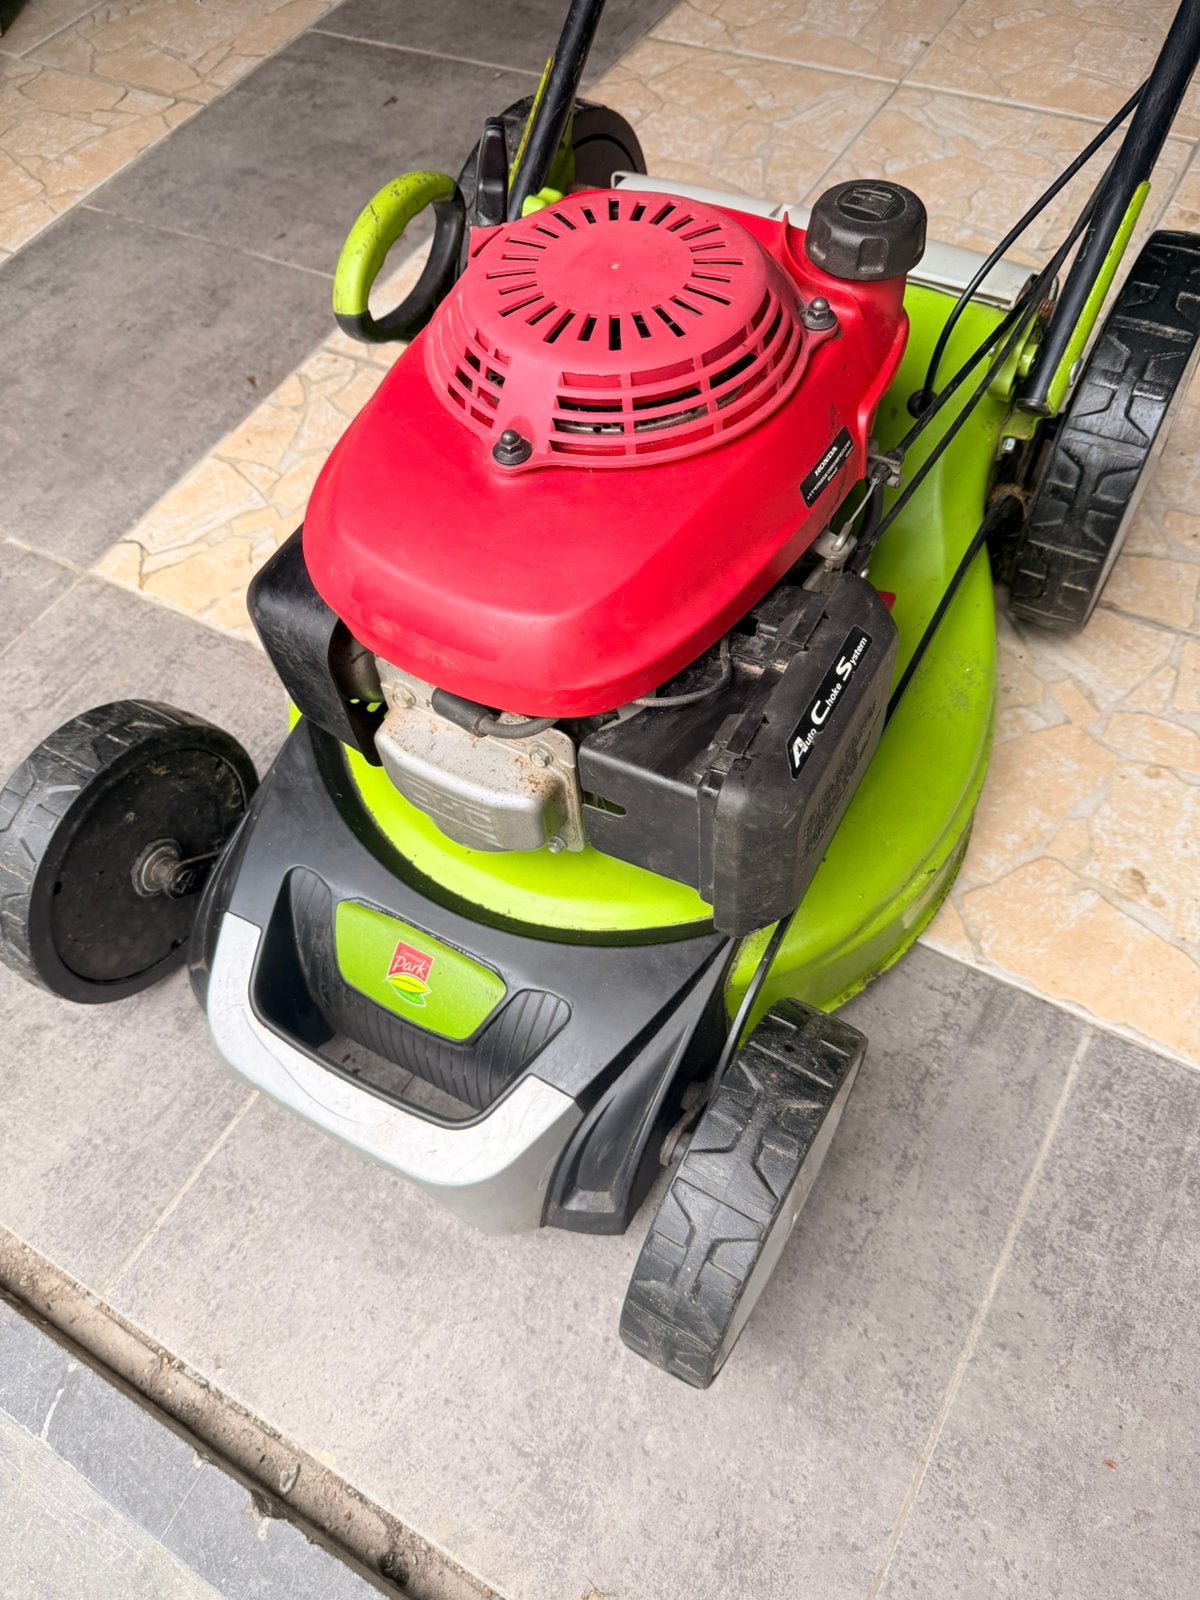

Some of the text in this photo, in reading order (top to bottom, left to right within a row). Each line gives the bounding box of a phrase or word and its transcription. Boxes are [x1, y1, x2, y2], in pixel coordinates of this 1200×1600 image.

[814, 446, 838, 477] HONDA
[793, 637, 868, 769] Auto Choke System
[391, 955, 427, 979] Park
